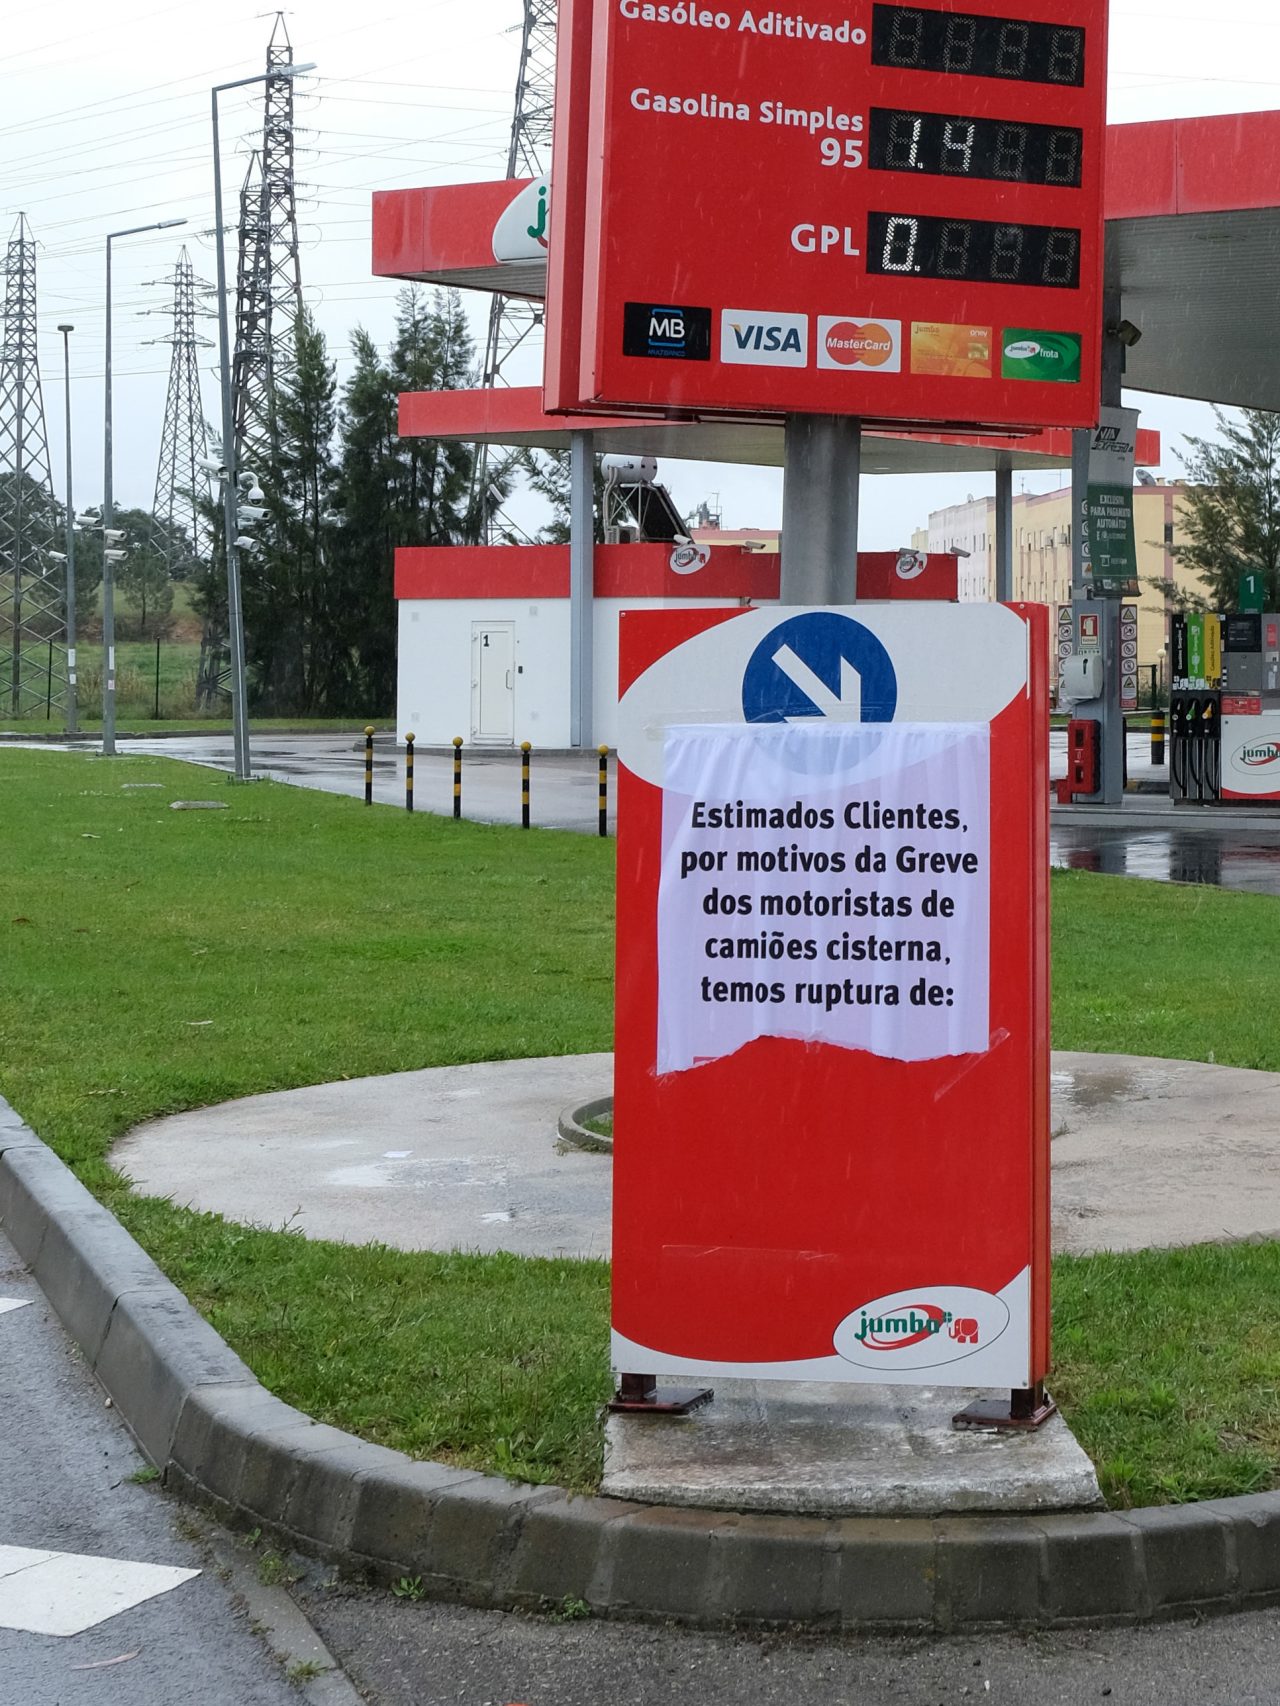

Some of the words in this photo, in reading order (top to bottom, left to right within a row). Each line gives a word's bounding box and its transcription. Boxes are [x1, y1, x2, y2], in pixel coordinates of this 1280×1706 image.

[619, 0, 731, 30] Gasóleo
[738, 10, 867, 45] Aditivado
[630, 87, 750, 121] Gasolina
[759, 101, 864, 135] Simples
[820, 137, 863, 168] 95
[790, 223, 860, 256] GPL
[649, 317, 685, 338] MB
[729, 323, 802, 353] VISA
[826, 336, 891, 351] MasterCard
[1040, 348, 1059, 359] frota
[1245, 575, 1256, 593] 1
[483, 634, 490, 647] 1
[691, 799, 835, 829] Estimados
[843, 800, 968, 833] Clientes,
[681, 851, 728, 879] por
[737, 843, 846, 873] motivos
[854, 844, 887, 873] da
[895, 845, 978, 874] Greve
[702, 887, 753, 916] dos
[760, 887, 913, 918] motoristas
[921, 889, 955, 918] de
[705, 930, 818, 961] camiões
[826, 931, 951, 965] cisterna,
[700, 976, 786, 1004] temos
[795, 978, 900, 1012] ruptura
[909, 977, 954, 1007] de:
[854, 1310, 940, 1340] jumbo
